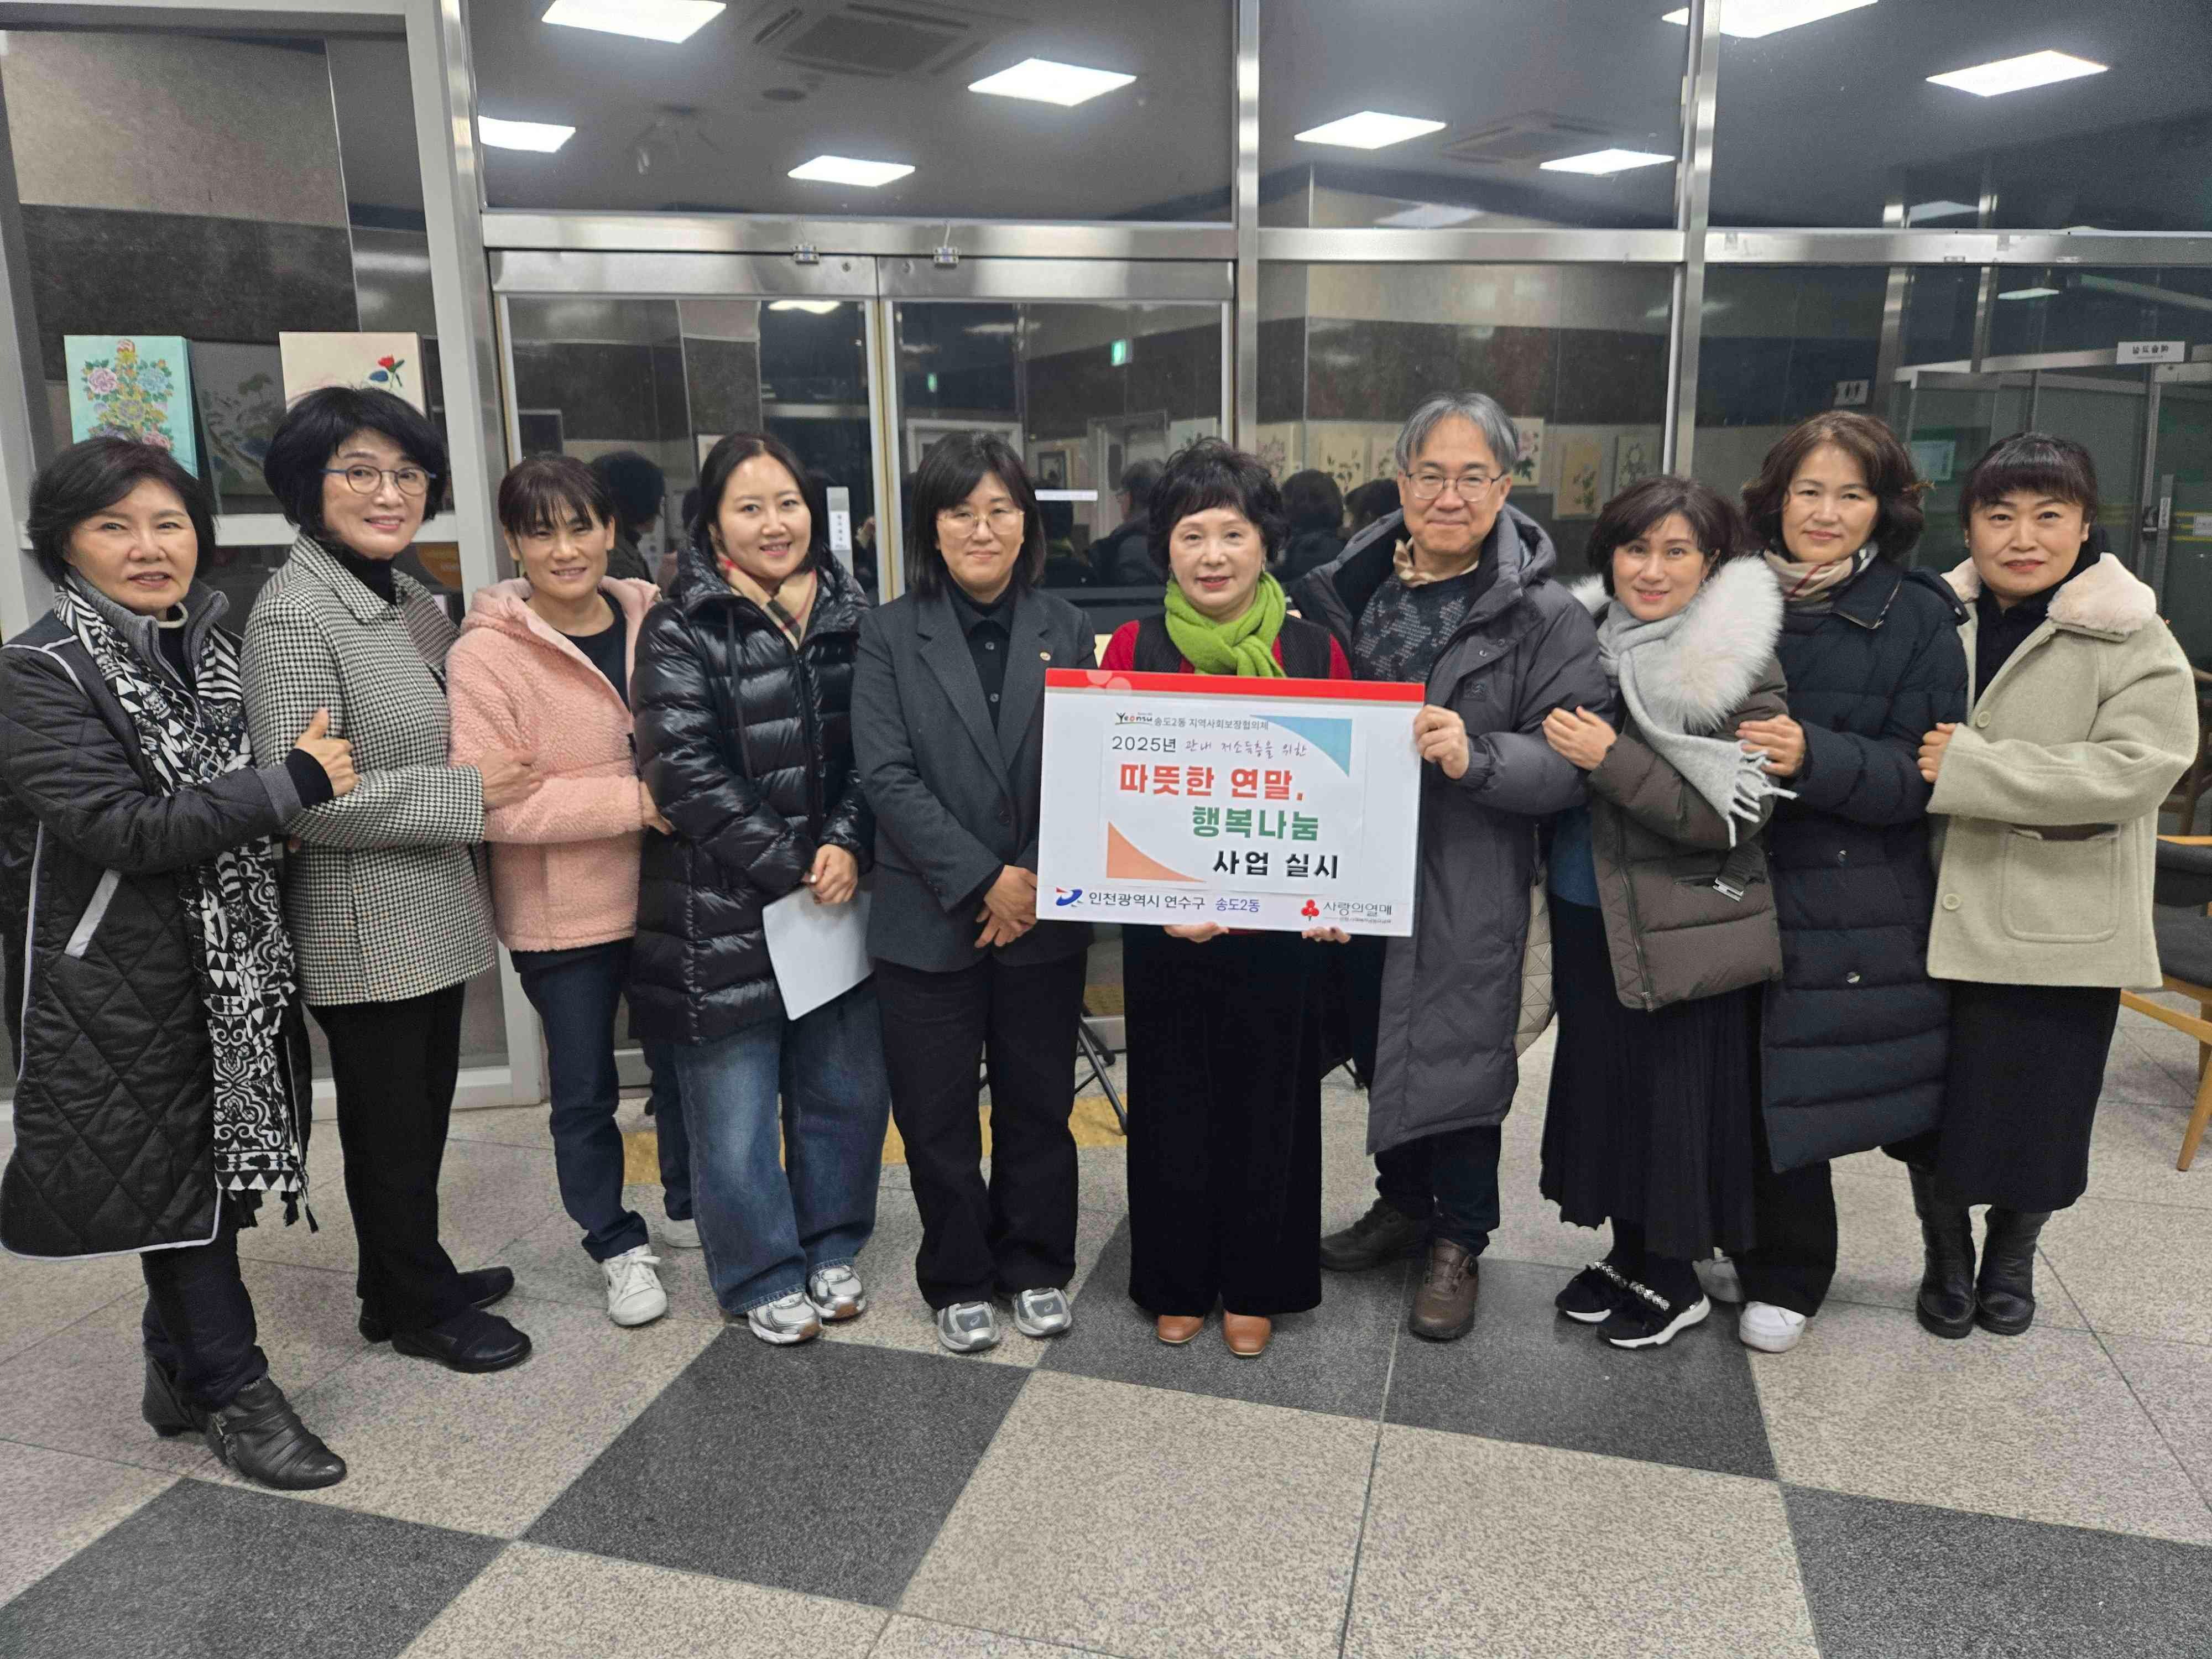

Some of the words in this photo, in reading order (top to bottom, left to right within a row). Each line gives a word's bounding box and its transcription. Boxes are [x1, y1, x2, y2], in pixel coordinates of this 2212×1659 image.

[1115, 712, 1153, 724] Yeonsu
[1154, 717, 1186, 728] 송도2동
[1189, 718, 1269, 731] 지역사회보장협의체
[1112, 735, 1176, 753] 2025년
[1185, 739, 1212, 753] 관내
[1220, 740, 1274, 759] 저소득층을
[1282, 742, 1307, 757] 위한
[1120, 764, 1215, 797] 따뜻한
[1192, 805, 1319, 841] 행복나눔
[1212, 850, 1269, 875] 사업
[1285, 853, 1338, 879] 실시
[1089, 891, 1160, 908] 인천광역시
[1164, 895, 1206, 910] 연수구
[1216, 898, 1261, 913] 송도2동
[1322, 901, 1392, 916] 사랑의열매
